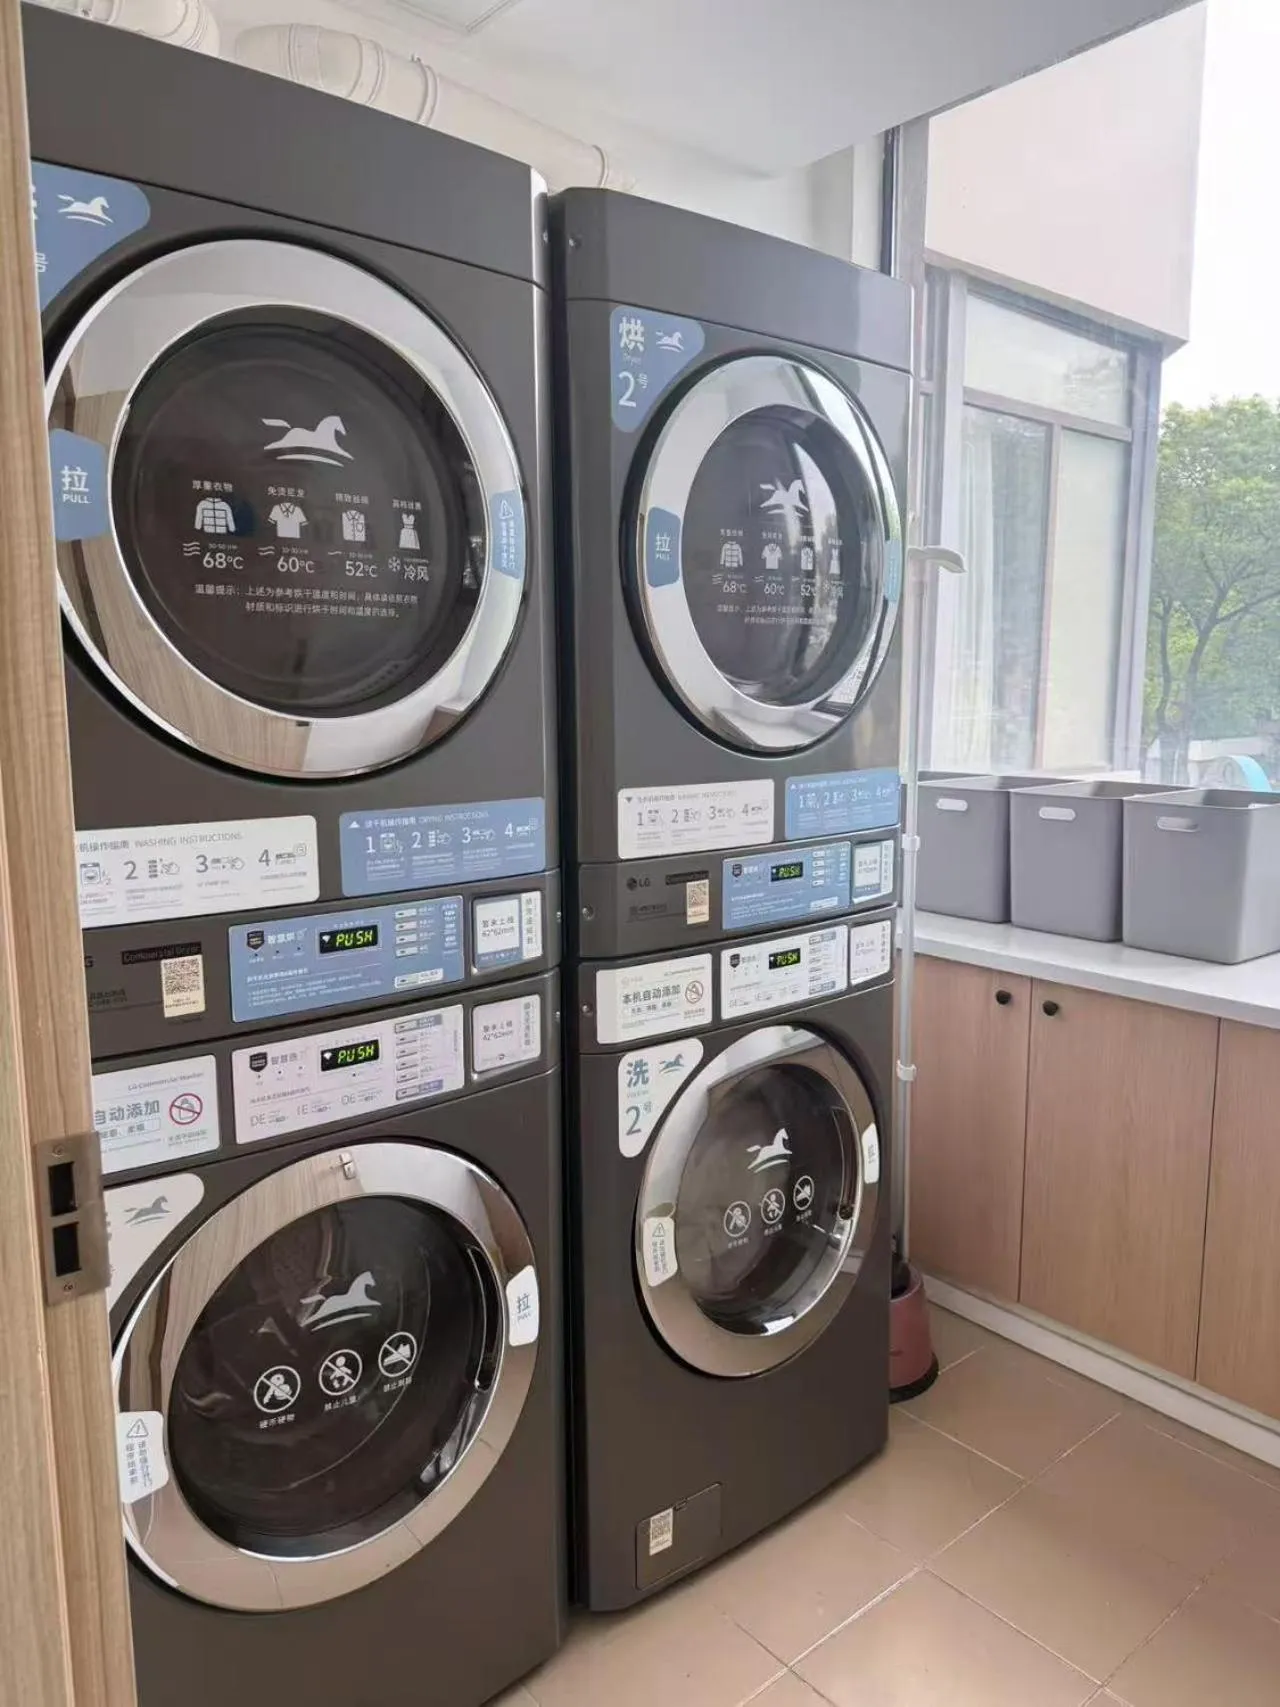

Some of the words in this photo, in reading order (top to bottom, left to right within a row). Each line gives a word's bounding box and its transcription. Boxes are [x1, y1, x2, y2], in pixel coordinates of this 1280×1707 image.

[619, 317, 645, 352] 烘
[61, 465, 89, 492] 拉
[63, 493, 91, 504] PULL
[656, 532, 671, 552] 拉
[403, 564, 429, 582] 冷风
[637, 812, 644, 826] 1
[671, 809, 679, 824] 2
[709, 806, 716, 820] 3
[742, 804, 749, 817] 4
[135, 837, 177, 848] WASHING
[180, 832, 243, 845] INSTRUCTIONS
[366, 836, 375, 853] 1
[411, 831, 422, 849] 2
[462, 827, 471, 844] 3
[505, 822, 513, 838] 4
[123, 860, 138, 880] 2
[195, 854, 209, 873] 3
[258, 849, 271, 867] 4
[639, 877, 651, 888] LG
[335, 929, 374, 948] PUSH
[337, 1044, 376, 1064] PUSH
[626, 1058, 650, 1088] 洗
[94, 1099, 160, 1126] 自动添加
[516, 1293, 531, 1314] 拉
